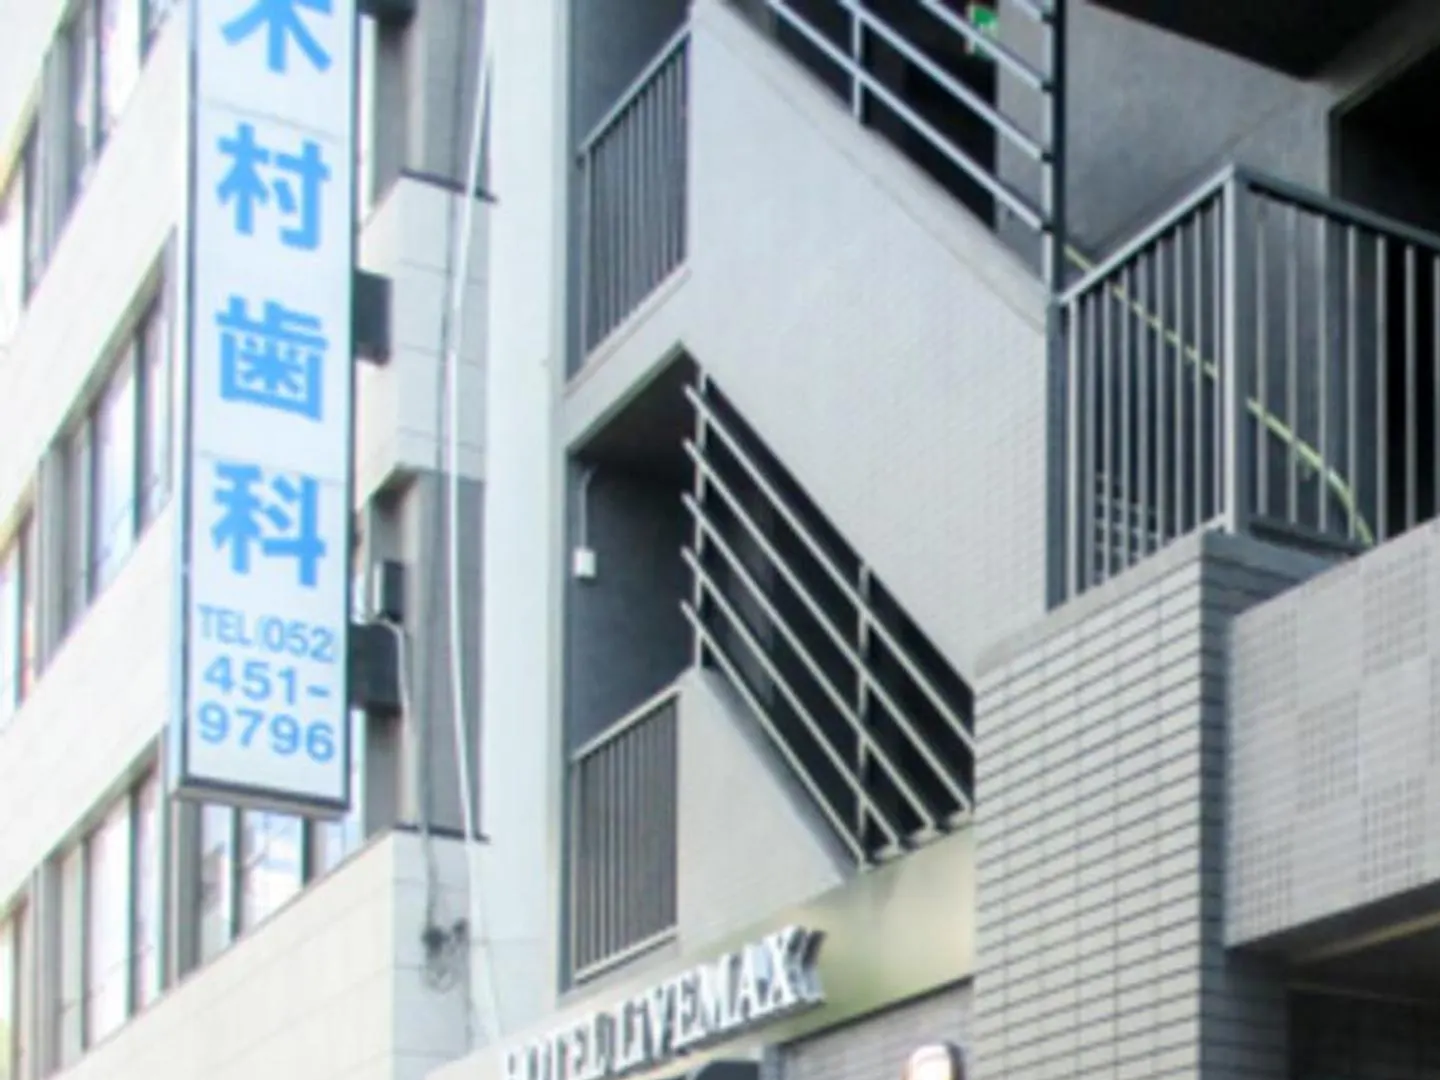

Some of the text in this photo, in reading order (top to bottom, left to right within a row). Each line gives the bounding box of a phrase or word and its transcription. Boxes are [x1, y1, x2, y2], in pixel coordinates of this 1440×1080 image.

[210, 0, 331, 588] 木村歯科
[198, 604, 252, 645] TEL
[198, 701, 335, 764] 9796
